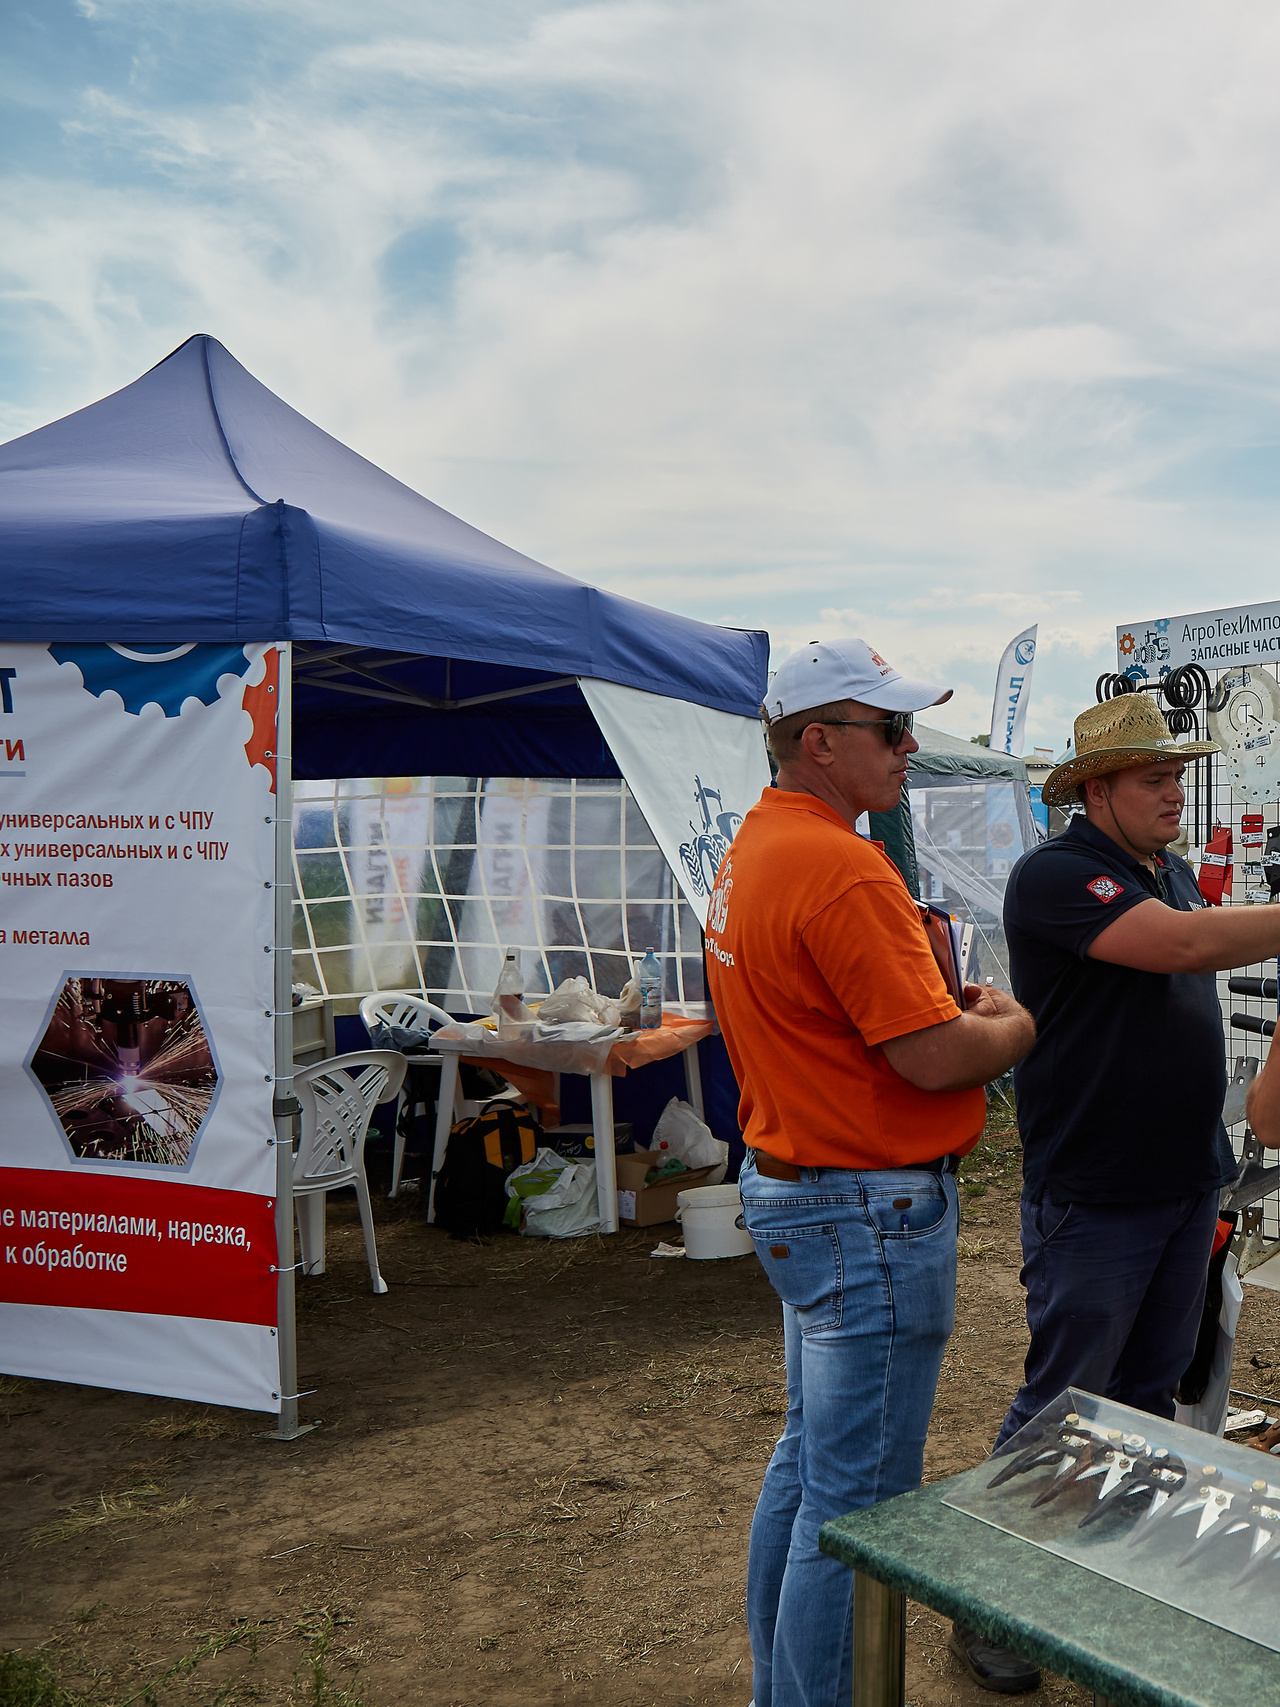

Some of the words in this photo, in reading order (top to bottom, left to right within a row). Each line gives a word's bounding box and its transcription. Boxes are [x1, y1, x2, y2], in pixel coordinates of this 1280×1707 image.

[1190, 642, 1250, 662] ЗАПАСНЫЕ
[149, 816, 159, 829] и
[164, 816, 175, 829] с
[179, 811, 214, 830] ЧПУ
[14, 843, 163, 861] универсальных
[168, 847, 178, 860] и
[182, 847, 193, 860] с
[196, 842, 229, 860] ЧПУ
[56, 874, 113, 888] пазов
[12, 931, 91, 946] металла
[20, 1209, 163, 1242] материалами,
[167, 1222, 252, 1251] нарезка,
[5, 1245, 17, 1261] к
[22, 1243, 128, 1273] обработке
